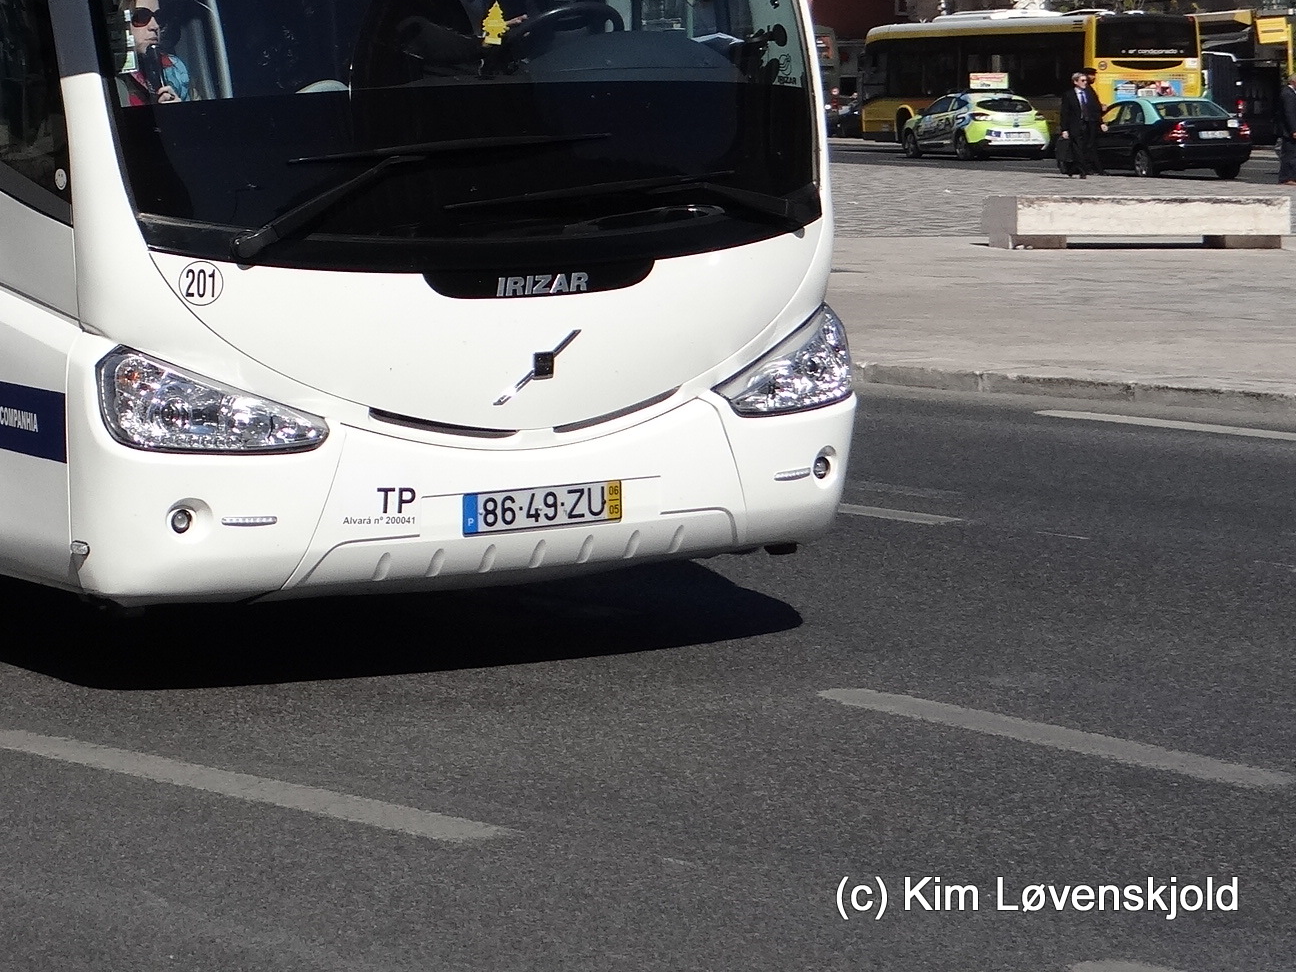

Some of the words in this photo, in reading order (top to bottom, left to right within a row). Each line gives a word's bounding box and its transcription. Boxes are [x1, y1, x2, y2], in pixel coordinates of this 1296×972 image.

[186, 268, 218, 298] 201
[496, 272, 588, 297] IRIZAR
[0, 406, 39, 433] COMPANHIA
[608, 485, 619, 496] 06
[377, 487, 416, 514] TP
[608, 504, 620, 515] 05
[343, 516, 371, 525] Alvará
[385, 516, 416, 525] 200041
[467, 518, 474, 526] P
